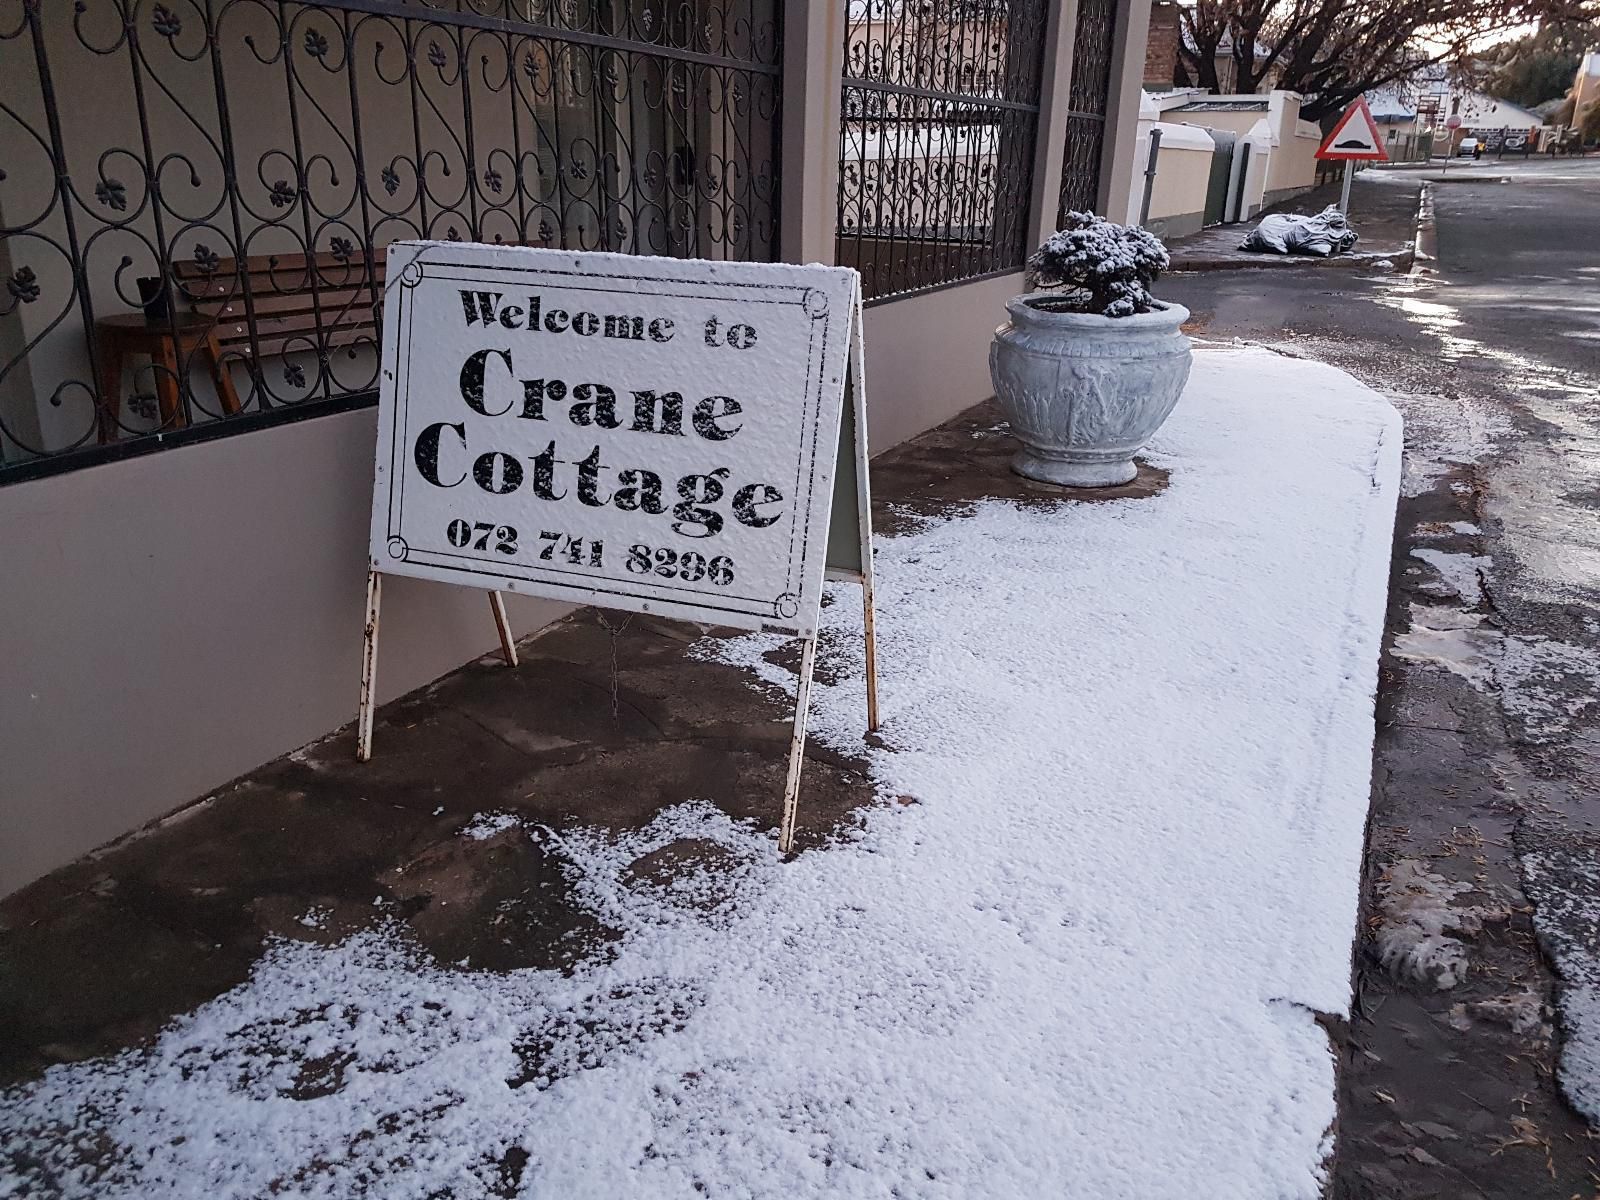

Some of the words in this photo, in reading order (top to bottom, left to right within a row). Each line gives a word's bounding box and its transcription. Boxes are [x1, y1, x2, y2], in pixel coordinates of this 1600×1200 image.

[458, 289, 675, 343] Welcome
[704, 315, 758, 350] to
[459, 348, 744, 441] Crane
[414, 422, 784, 538] Cottage
[447, 518, 518, 554] 072
[539, 530, 604, 568] 741
